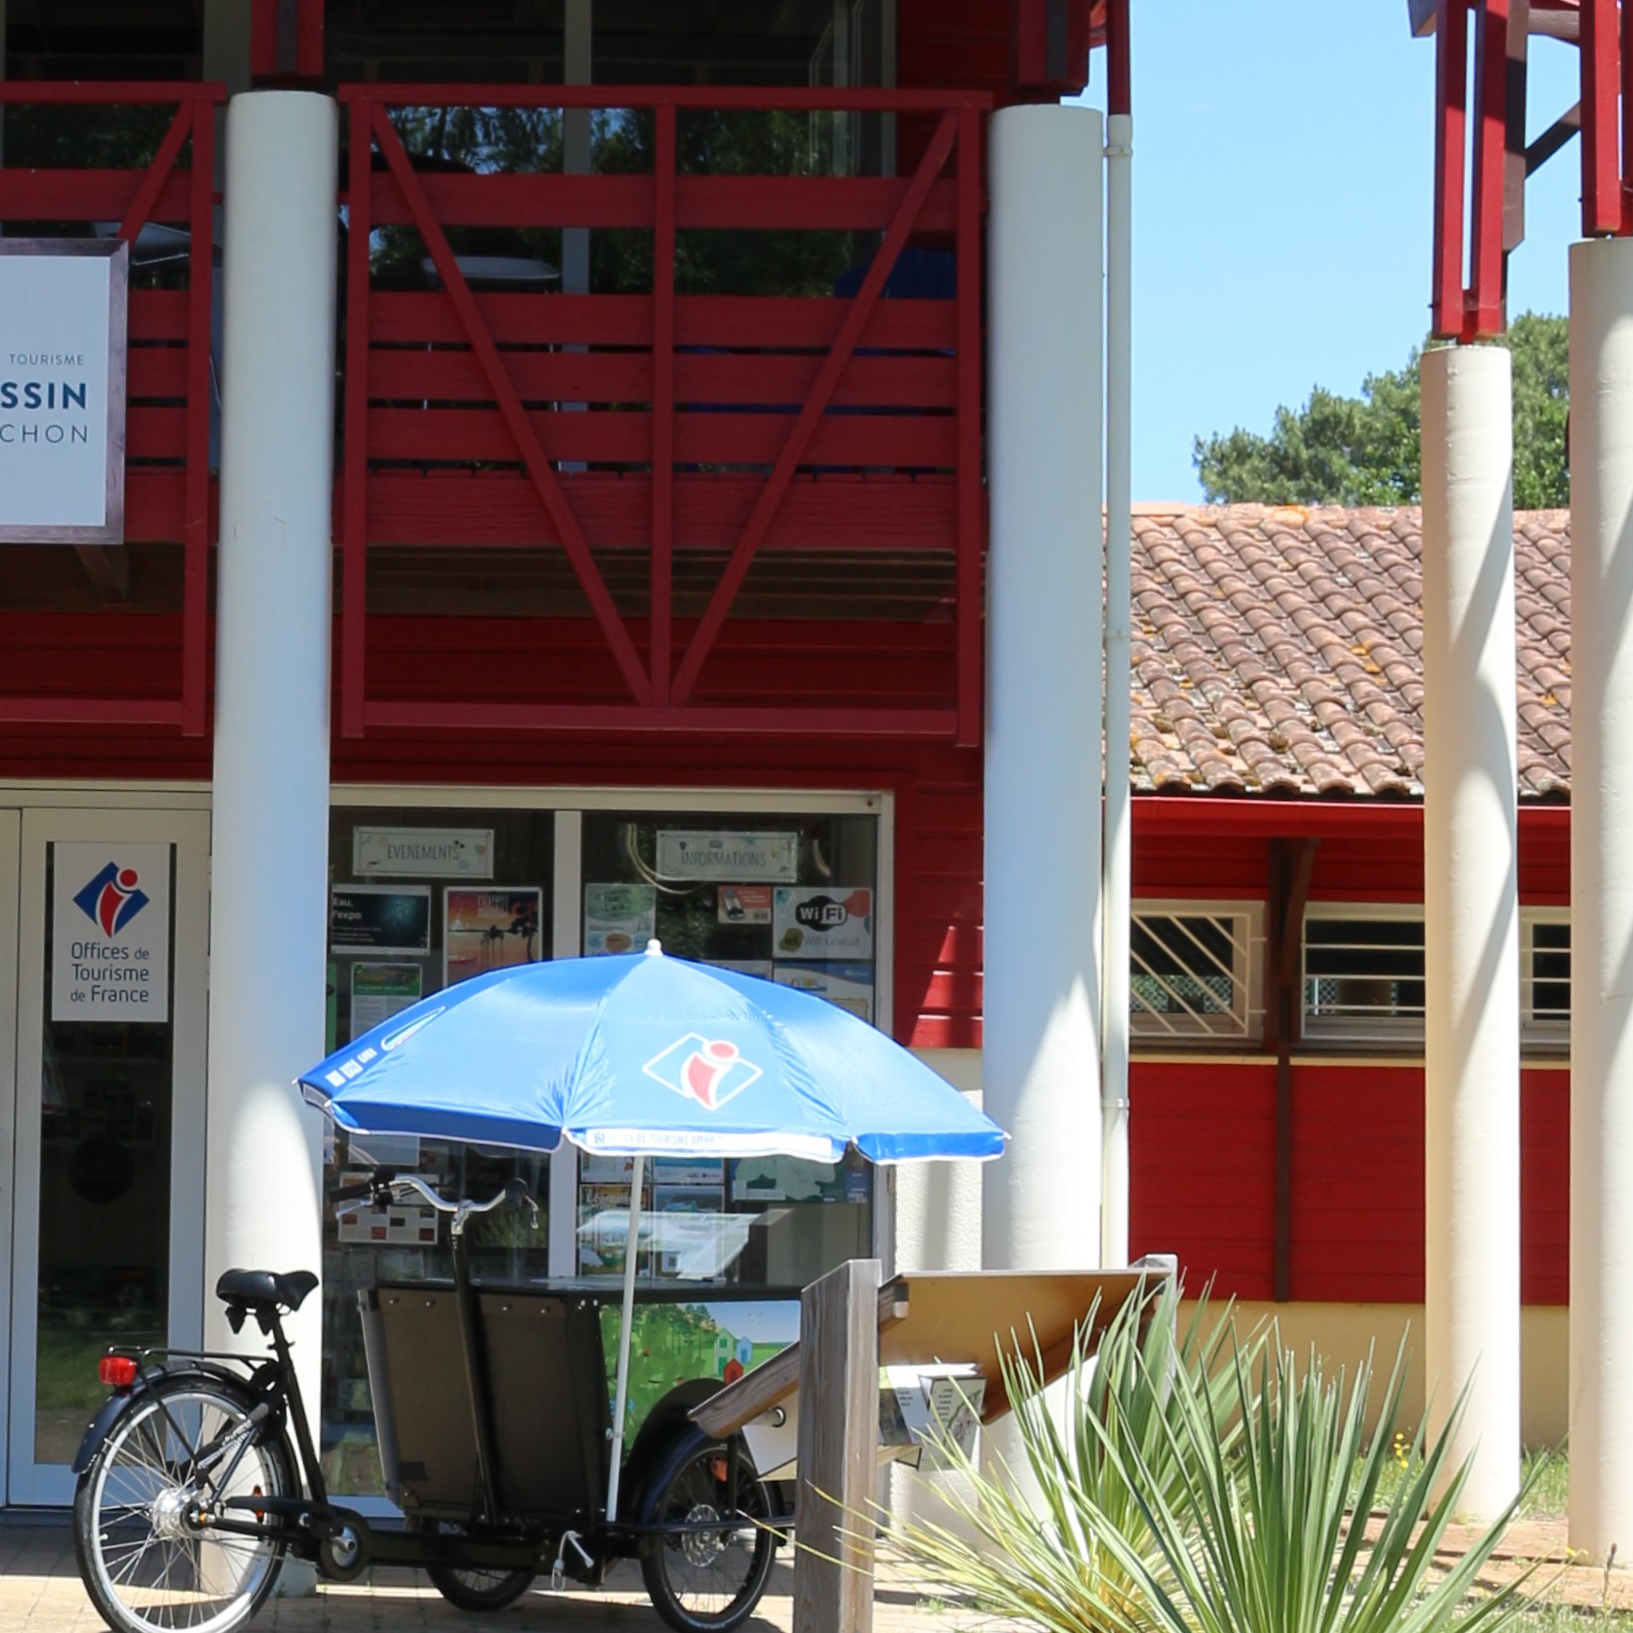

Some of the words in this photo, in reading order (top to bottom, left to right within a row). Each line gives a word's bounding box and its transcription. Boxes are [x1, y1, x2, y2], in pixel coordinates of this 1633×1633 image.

[9, 353, 85, 366] TOURISME
[386, 843, 461, 861] EVENEMENTS
[680, 850, 766, 866] INFORMATIONS
[71, 942, 130, 960] Offices
[134, 947, 150, 961] de
[71, 964, 150, 981] Tourisme
[70, 989, 86, 1002] de
[91, 985, 150, 1003] France
